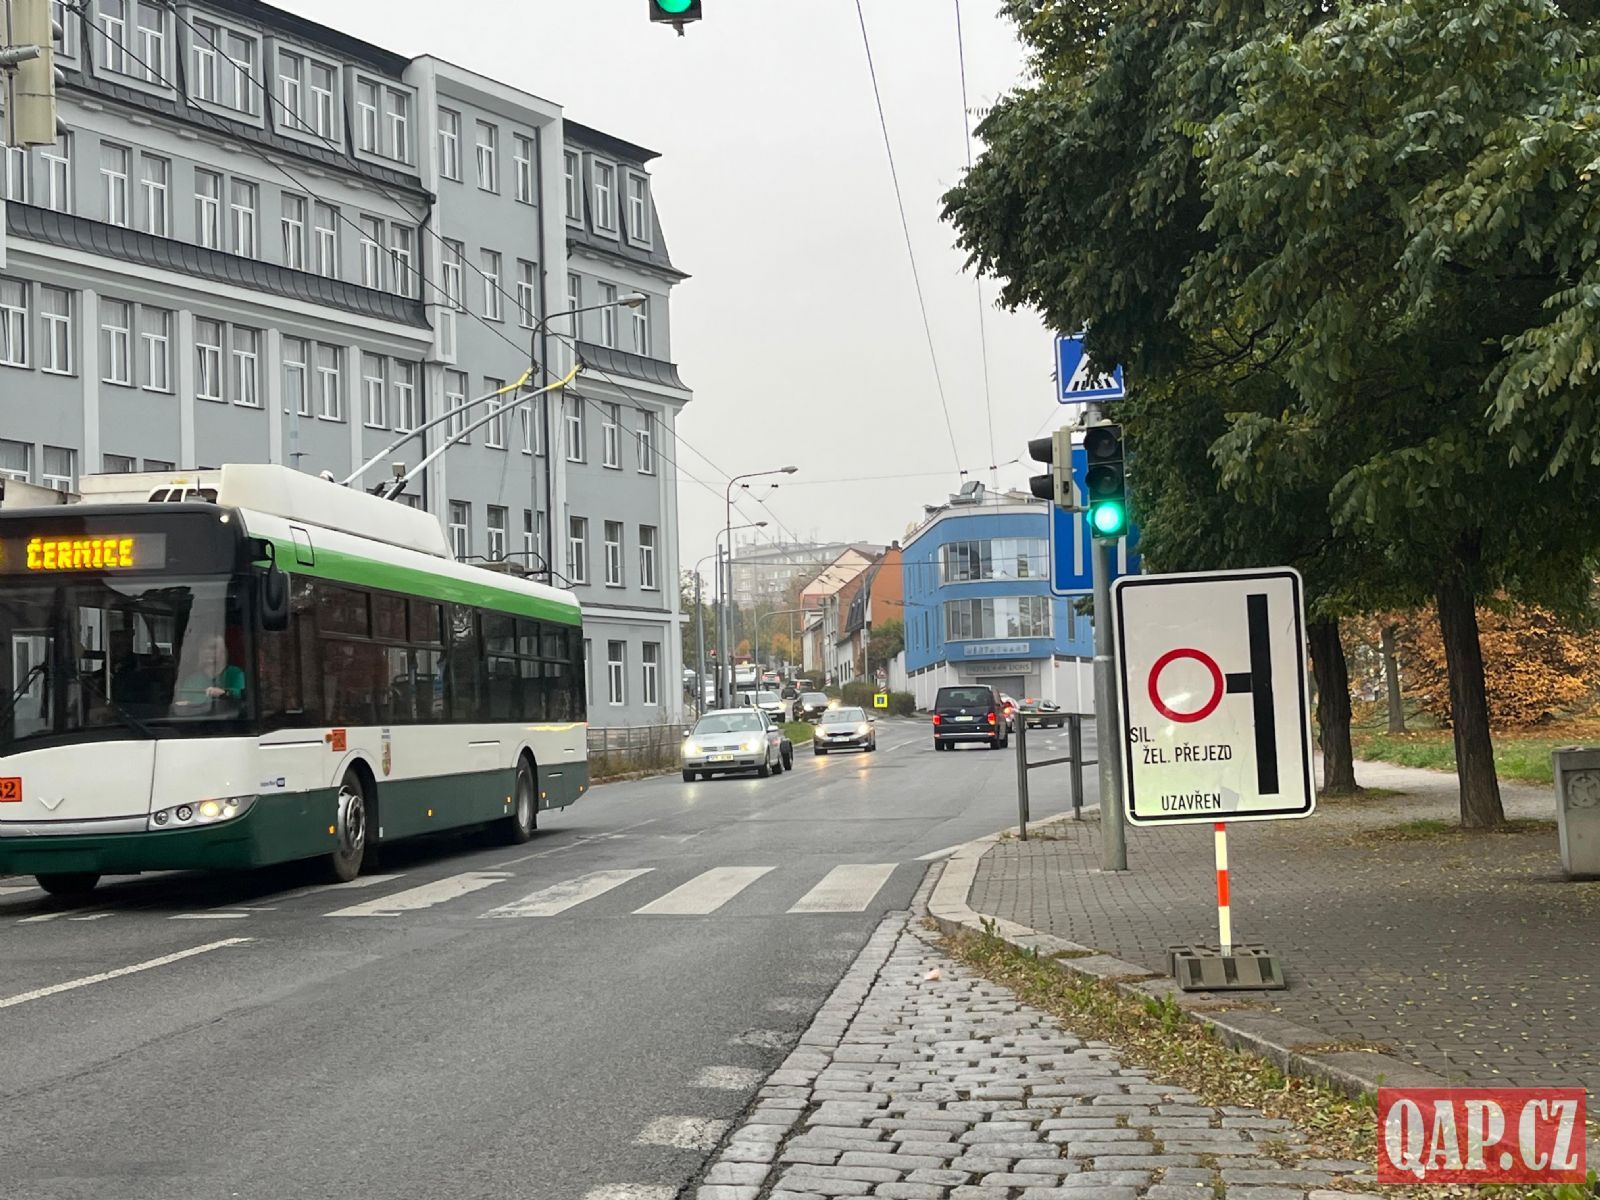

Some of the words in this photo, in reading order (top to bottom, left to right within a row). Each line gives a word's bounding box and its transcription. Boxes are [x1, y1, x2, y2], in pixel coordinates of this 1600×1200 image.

[1130, 727, 1155, 743] SIL.
[1143, 745, 1171, 764] ŽEL.
[1175, 742, 1232, 762] PŘEJEZD
[0, 781, 16, 799] 2
[1161, 790, 1221, 810] UZAVŘEN
